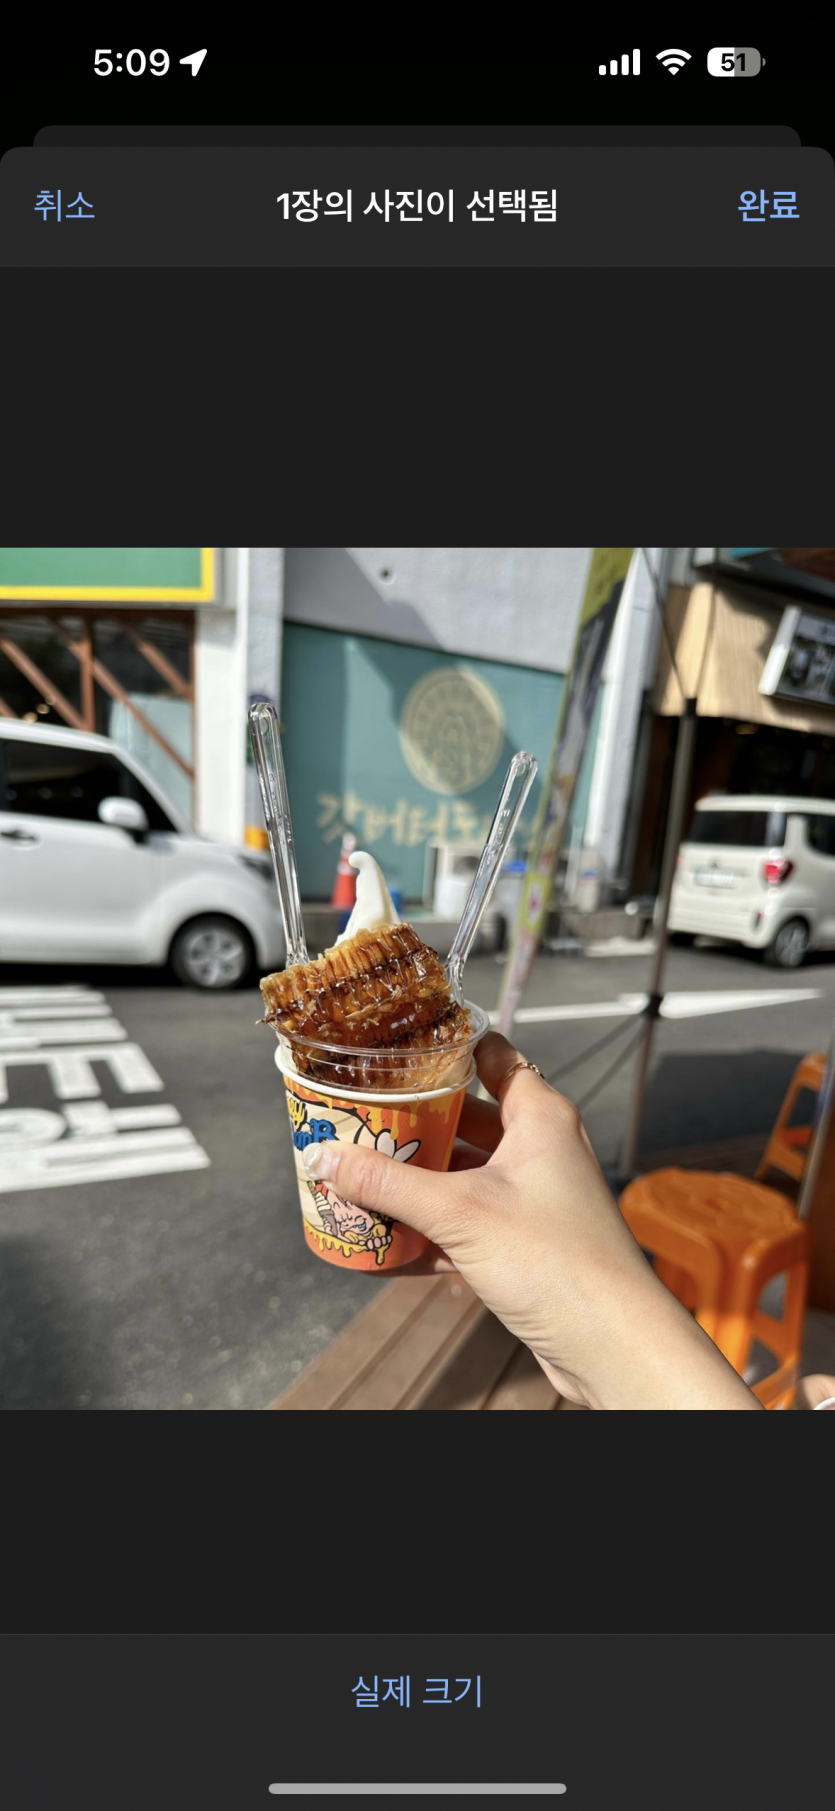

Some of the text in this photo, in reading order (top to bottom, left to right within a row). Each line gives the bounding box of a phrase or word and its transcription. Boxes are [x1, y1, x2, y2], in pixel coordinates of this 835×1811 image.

[93, 48, 171, 77] 5:09
[721, 52, 746, 72] 51
[33, 189, 96, 223] 취소
[276, 188, 557, 223] 1장의 사진이 선택됨
[737, 188, 801, 222] 완료
[351, 1674, 481, 1709] 실제 크기
